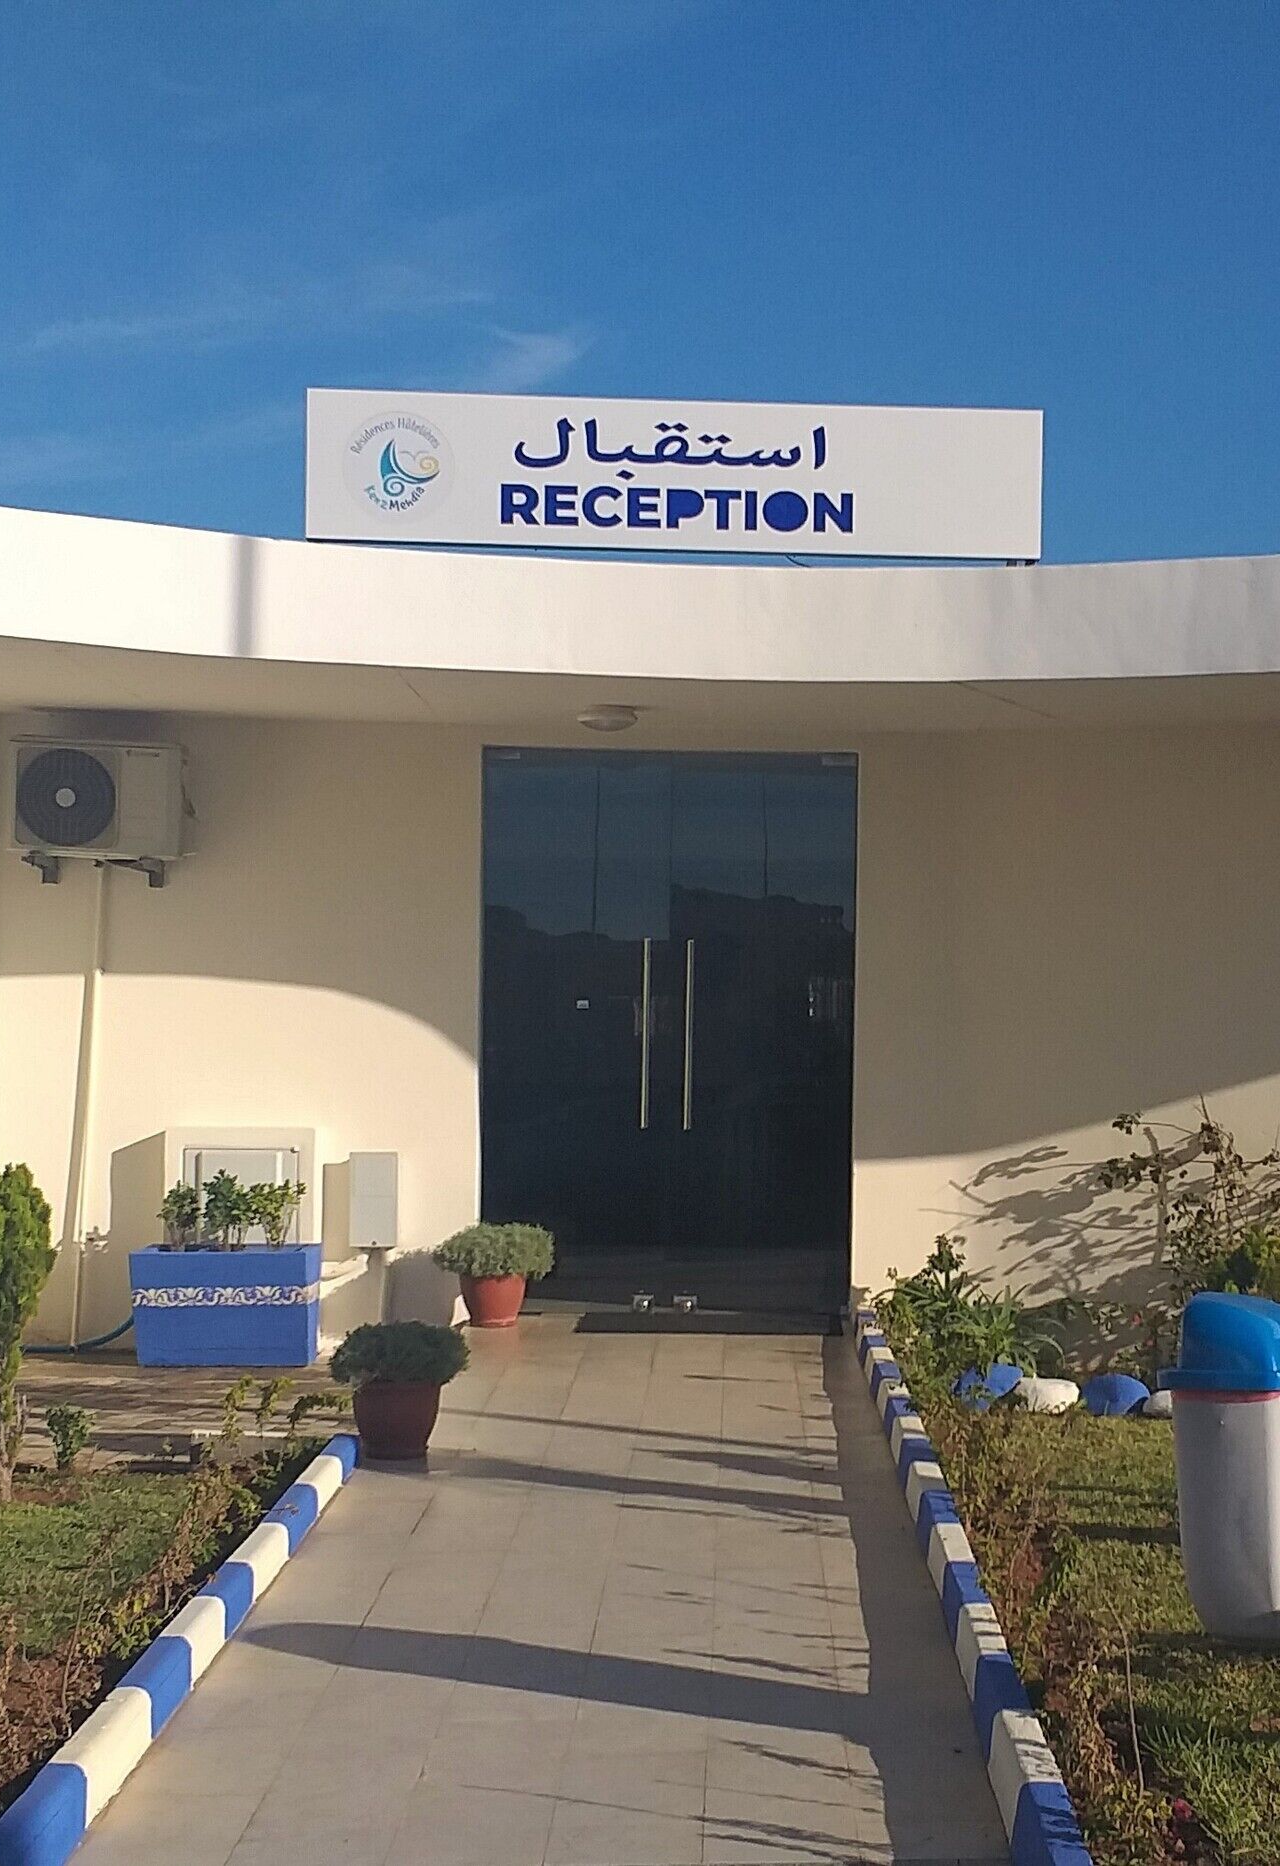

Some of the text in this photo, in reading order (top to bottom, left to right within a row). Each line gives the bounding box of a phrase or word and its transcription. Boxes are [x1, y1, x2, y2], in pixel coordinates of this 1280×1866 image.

[350, 420, 395, 454] Résidences
[514, 417, 826, 481] استقبال
[500, 483, 854, 534] RECEPTION
